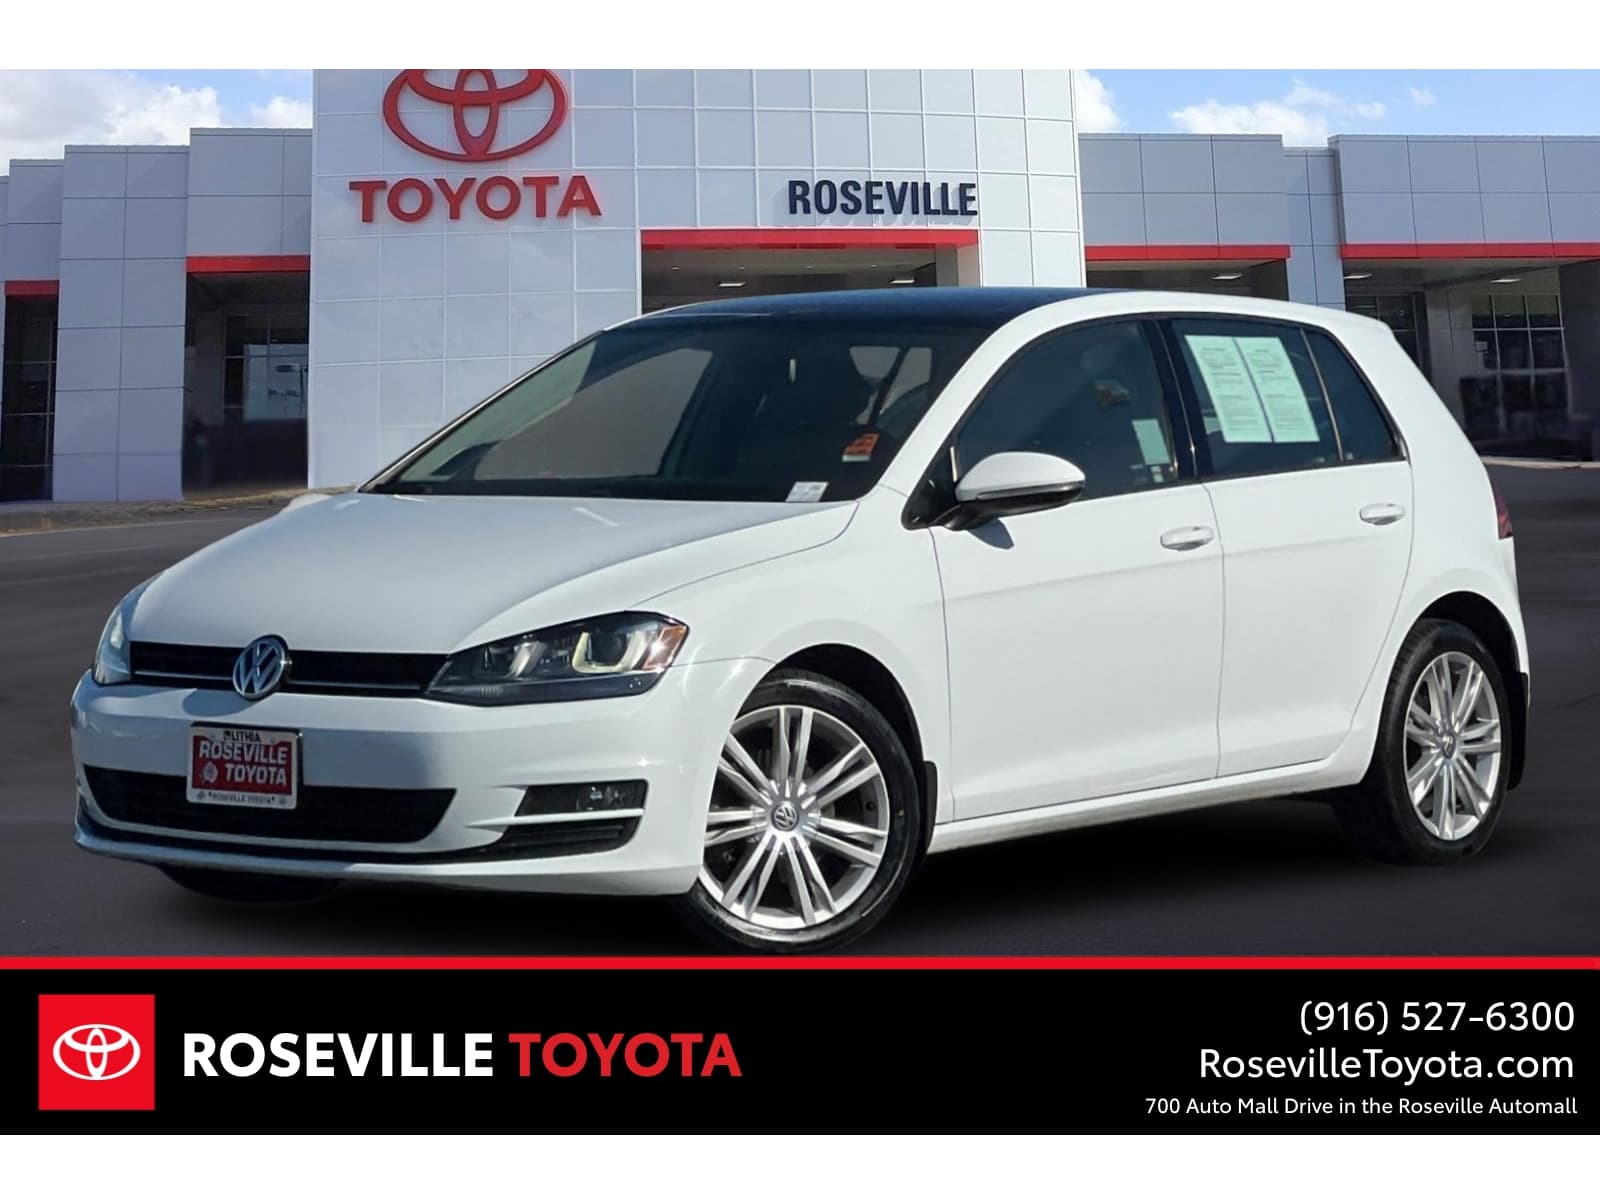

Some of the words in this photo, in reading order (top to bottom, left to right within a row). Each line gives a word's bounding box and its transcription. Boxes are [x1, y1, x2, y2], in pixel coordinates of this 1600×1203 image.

[350, 175, 601, 223] TOYOTA
[788, 179, 978, 217] ROSEVILLE
[231, 730, 261, 743] LITHIA
[200, 740, 288, 764] ROSEVILLE
[225, 763, 287, 786] TOYOTA
